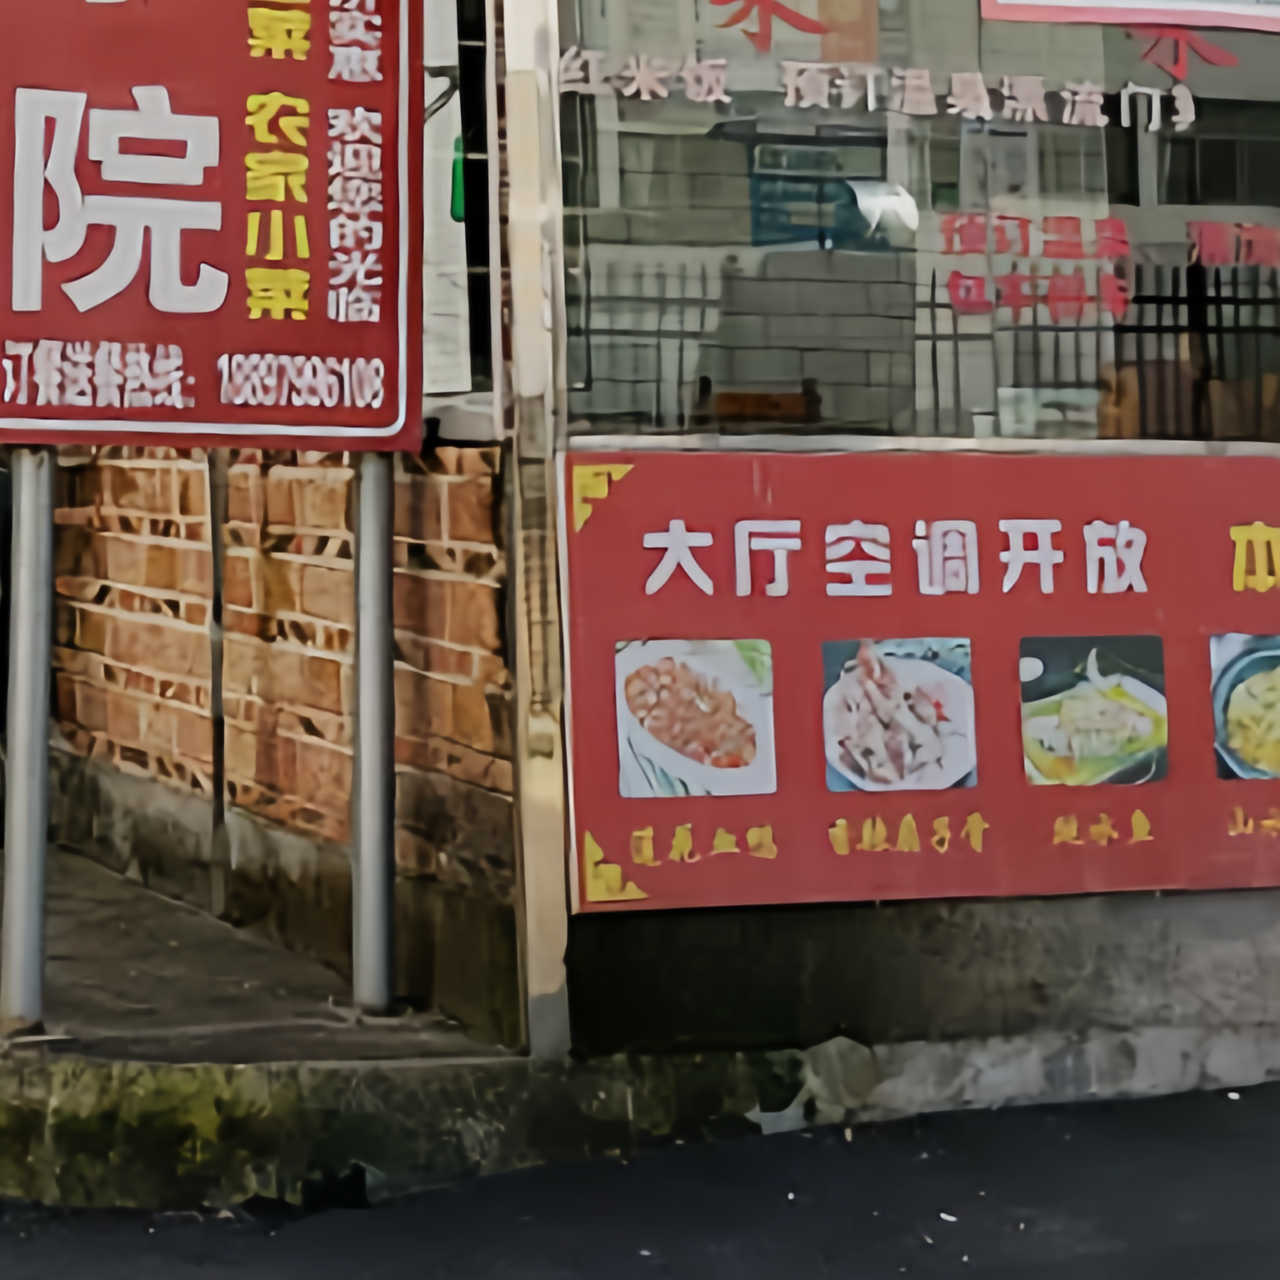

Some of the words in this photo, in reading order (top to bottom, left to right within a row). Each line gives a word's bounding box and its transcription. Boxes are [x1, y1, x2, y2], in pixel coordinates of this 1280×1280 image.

[558, 45, 732, 104] 红米饭
[245, 91, 310, 320] 农家小菜
[326, 106, 384, 323] 欢迎您的光临
[642, 518, 1150, 598] 大厅空调开放
